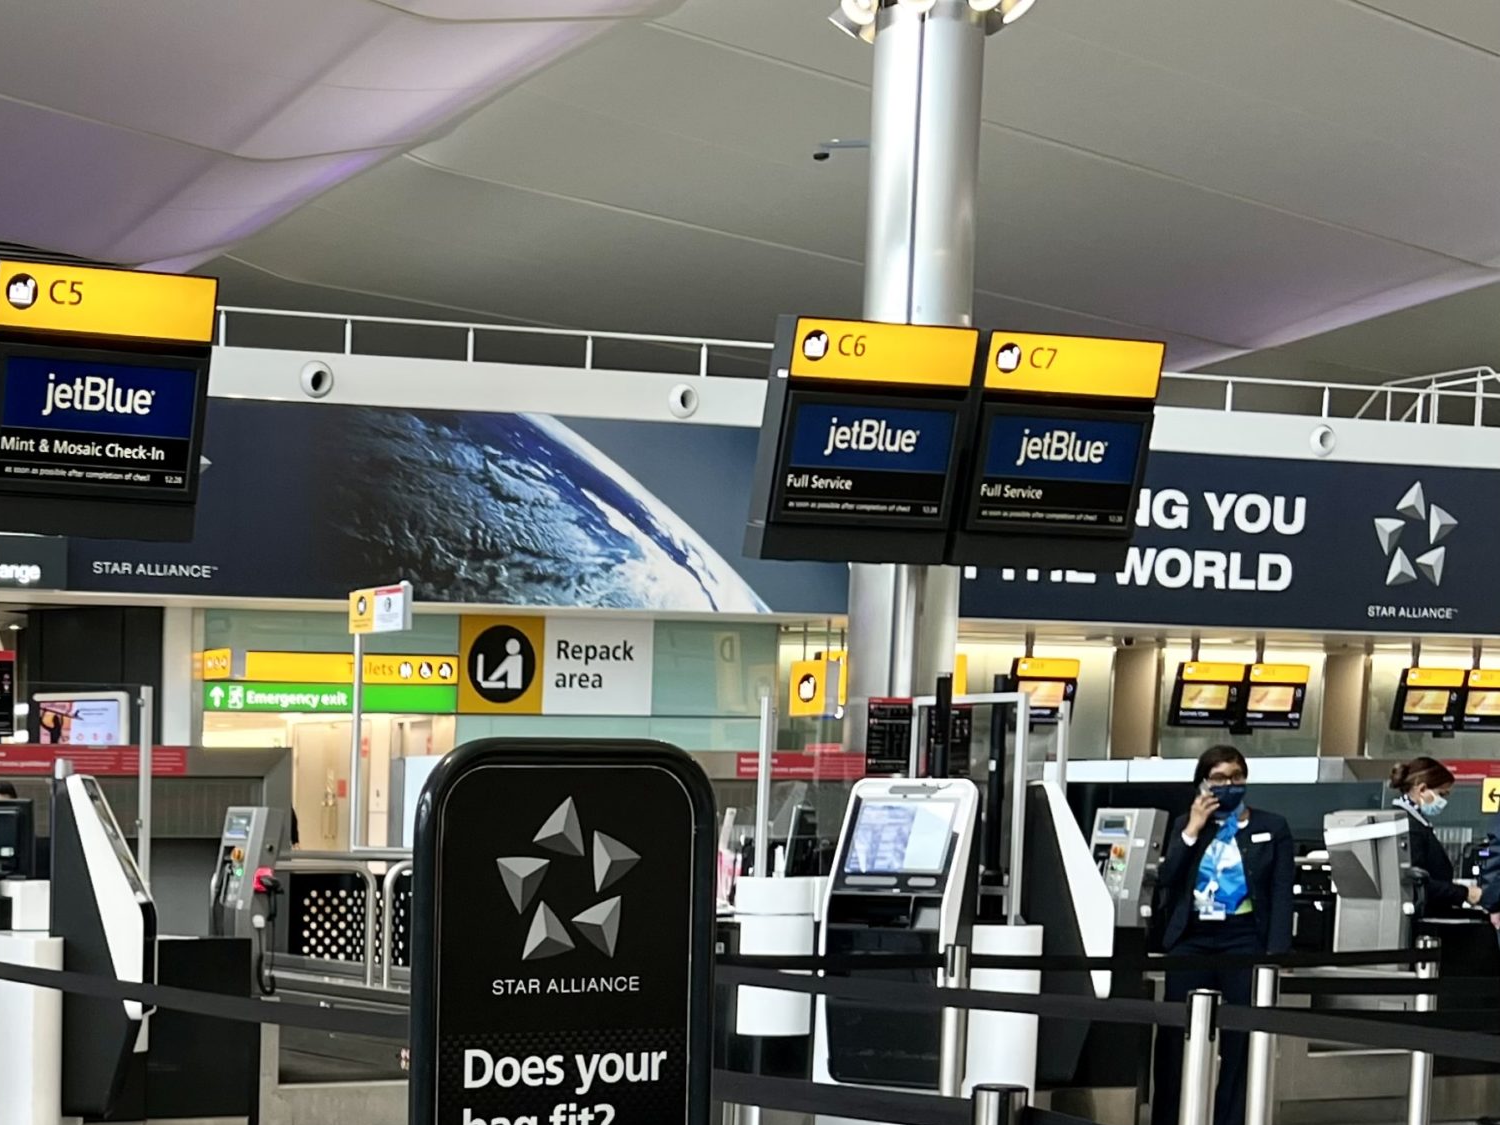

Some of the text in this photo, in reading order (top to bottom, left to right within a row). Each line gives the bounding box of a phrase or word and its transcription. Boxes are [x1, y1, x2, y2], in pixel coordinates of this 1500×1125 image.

[49, 279, 84, 305] C5
[837, 334, 866, 357] C6
[1030, 347, 1058, 370] C7
[42, 373, 153, 416] jetBlue
[824, 417, 918, 456] jetBlue
[1017, 428, 1106, 466] jetBlue
[0, 436, 165, 461] Mint & Mosaic Check-In
[786, 473, 853, 490] Full Service
[980, 483, 1043, 499] Full Service
[1204, 492, 1306, 535] YOU
[92, 561, 212, 579] STAR ALLIANCE
[1115, 547, 1292, 591] WORLD
[1367, 605, 1453, 619] STAR ALLIANCE
[556, 640, 634, 662] Repack
[347, 661, 394, 676] Tilets
[554, 671, 603, 689] area
[246, 690, 348, 708] Emergency exit
[492, 976, 640, 995] STAR ALLIANCE
[464, 1049, 667, 1095] Does your
